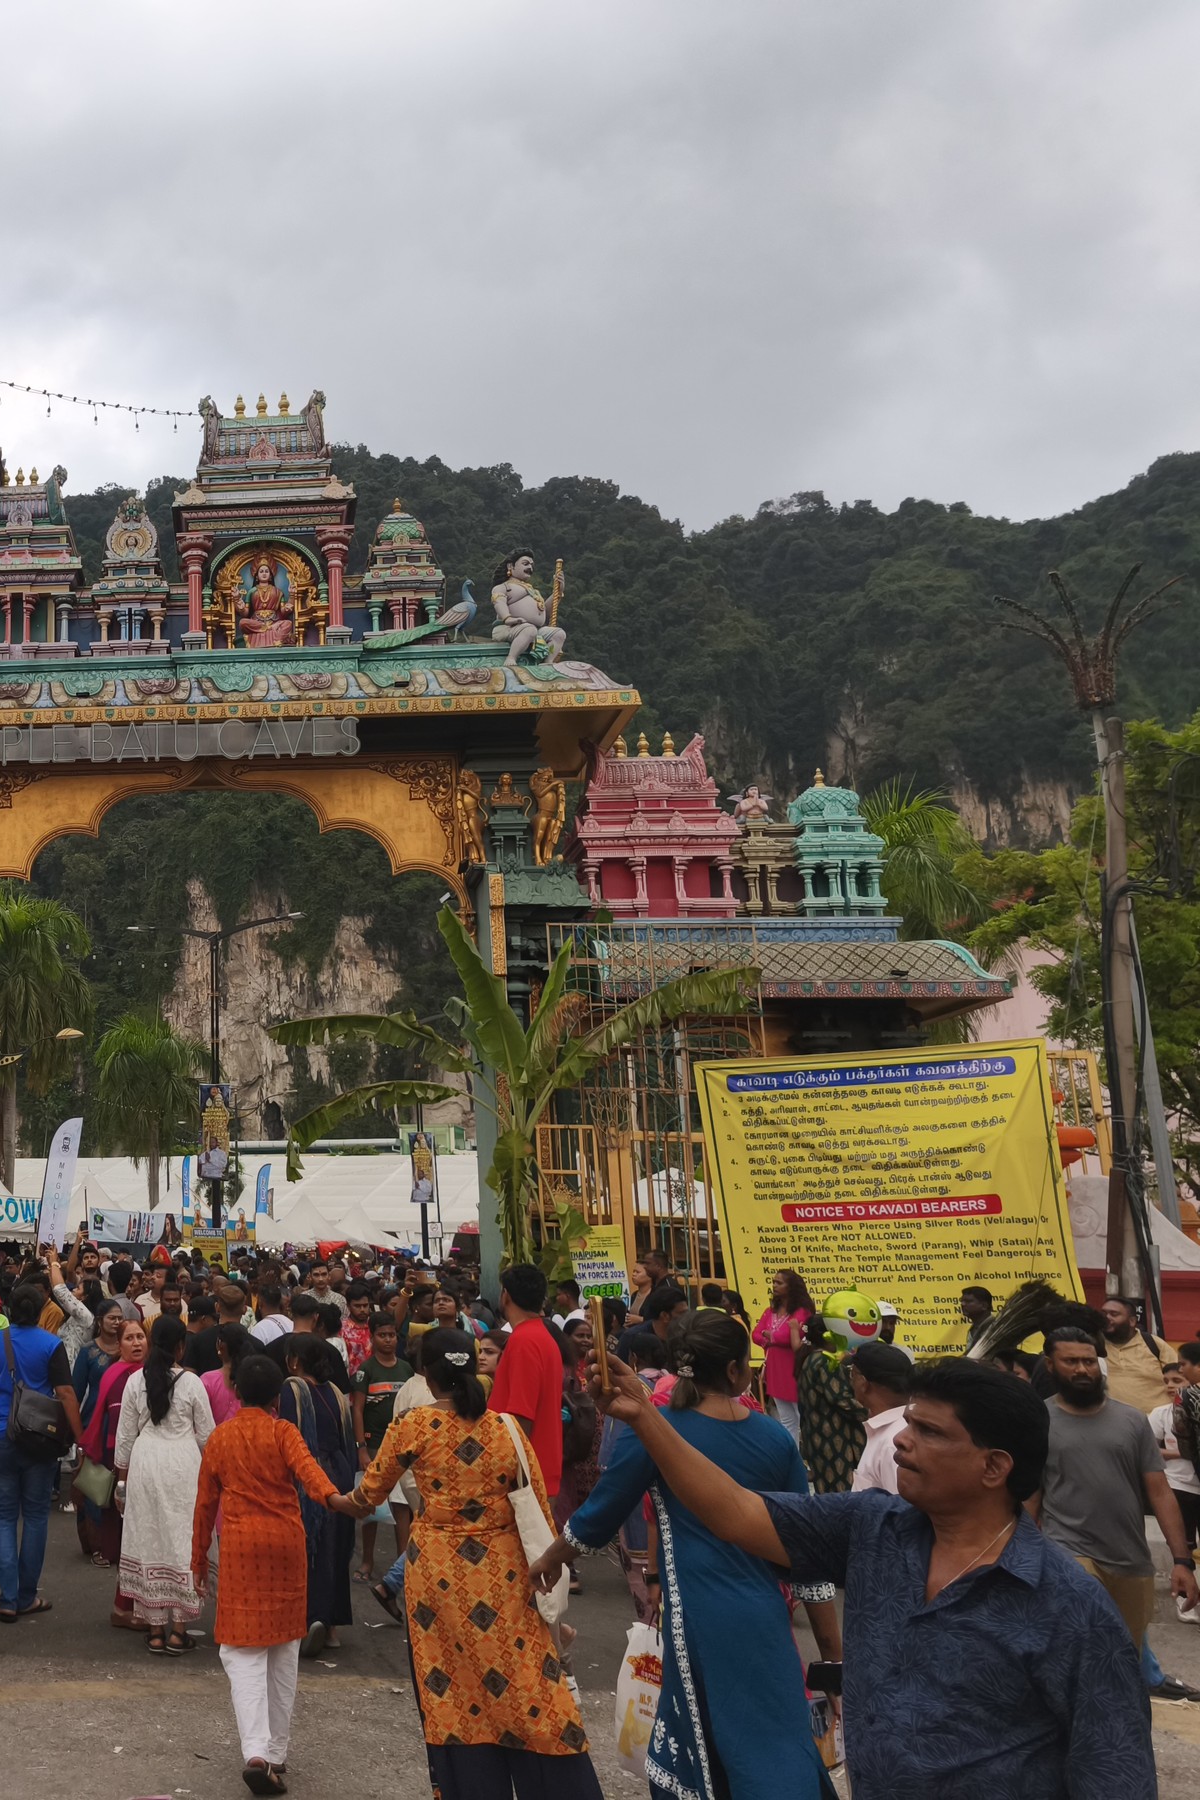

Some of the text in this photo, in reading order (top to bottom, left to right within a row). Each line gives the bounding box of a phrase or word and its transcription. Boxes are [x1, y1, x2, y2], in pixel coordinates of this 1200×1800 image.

[91, 720, 199, 763] BATU
[217, 717, 361, 760] CAVES
[737, 1060, 1006, 1087] காவடி எடுக்கும் பக்தர்கள் கவனத்திற்கு
[796, 1200, 986, 1218] NOTICE TO KAVADI BEARERS
[757, 1225, 788, 1233] Kavadi
[894, 1221, 922, 1229] Using
[956, 1218, 980, 1226] Rods
[798, 1234, 818, 1242] Feet
[865, 1231, 916, 1241] ALLOWED.
[761, 1246, 787, 1255] Using
[806, 1245, 833, 1253] Knife,
[838, 1244, 882, 1252] Machete,
[886, 1242, 917, 1251] Sword
[922, 1241, 966, 1251] (Parang),
[970, 1240, 993, 1248] Whip
[1037, 1237, 1054, 1245] And
[808, 1255, 830, 1263] That
[856, 1254, 891, 1262] Temple
[896, 1252, 959, 1262] Management
[987, 1249, 1041, 1259] Dangerous
[1046, 1249, 1056, 1258] By
[577, 1262, 615, 1270] THAIPUSAM
[882, 1263, 934, 1272] ALLOWED.
[574, 1272, 586, 1280] ASK
[589, 1271, 608, 1279] FORCE
[898, 1274, 916, 1282] And
[920, 1273, 954, 1282] Person
[957, 1273, 971, 1281] On
[974, 1272, 1011, 1280] Alcohol
[1015, 1271, 1062, 1280] Influence
[583, 1282, 622, 1299] GREEN
[913, 1296, 924, 1304] As
[896, 1307, 951, 1315] Procession
[904, 1318, 937, 1326] Nature
